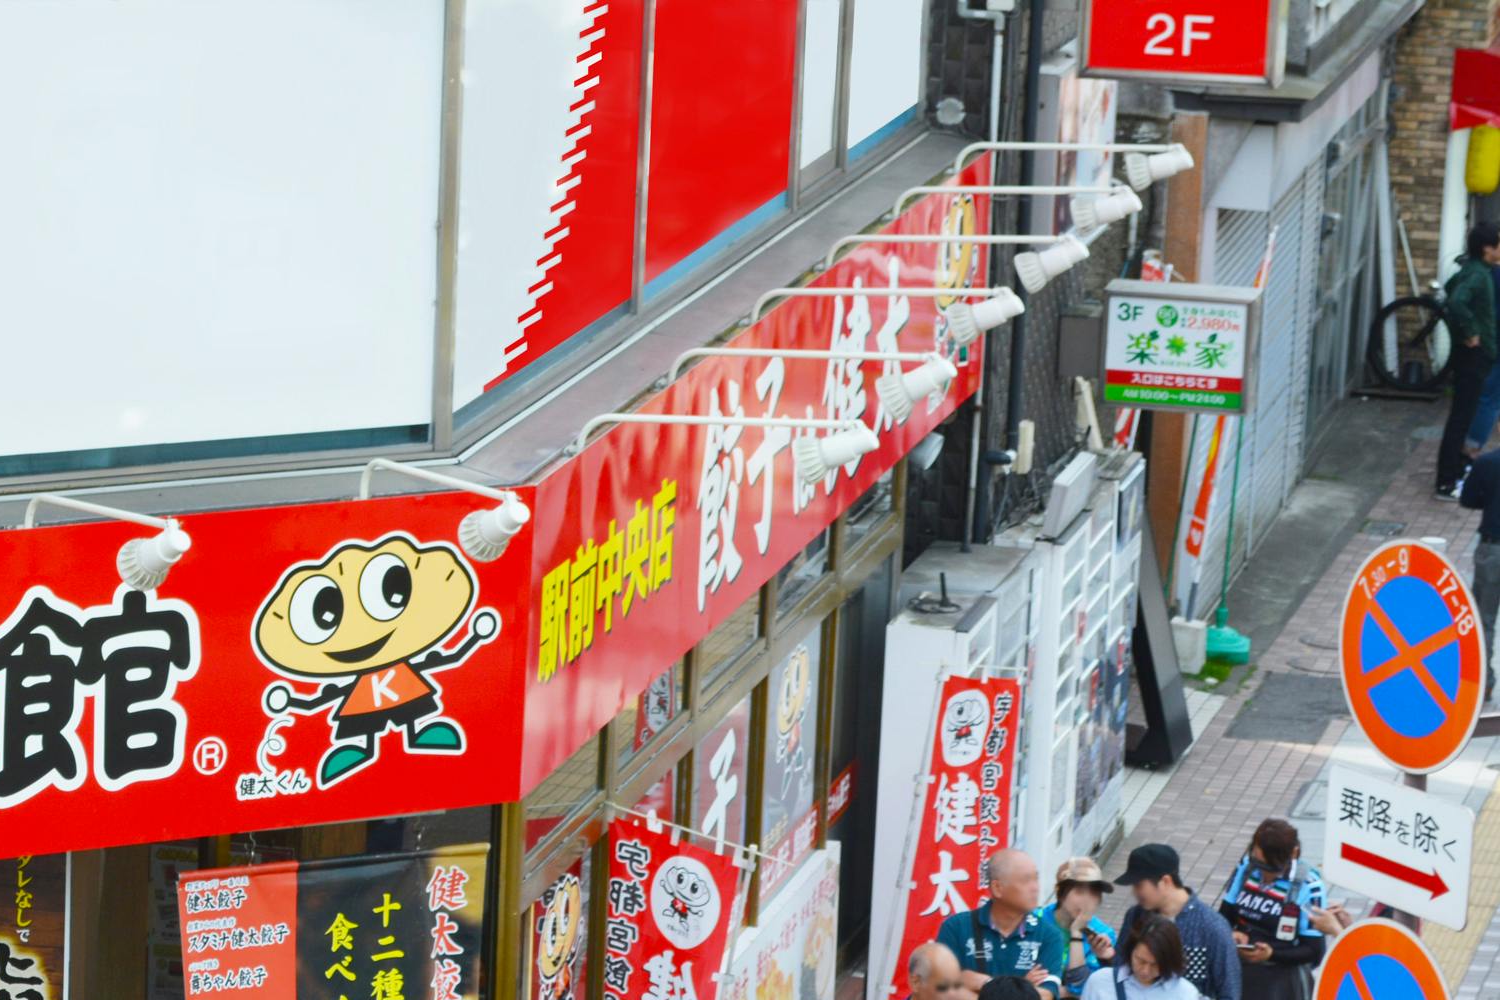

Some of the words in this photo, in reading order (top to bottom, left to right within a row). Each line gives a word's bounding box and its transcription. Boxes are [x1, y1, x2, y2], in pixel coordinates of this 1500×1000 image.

[1143, 13, 1215, 57] 2F
[1117, 302, 1144, 321] 3F
[537, 478, 678, 683] 駅前中央店
[1437, 568, 1474, 636] 17-18
[238, 772, 308, 797] 健太くん
[1339, 787, 1457, 863] 乗降を除く
[187, 889, 246, 913] 健太餃子
[188, 924, 289, 952] スタミナ健太餃子
